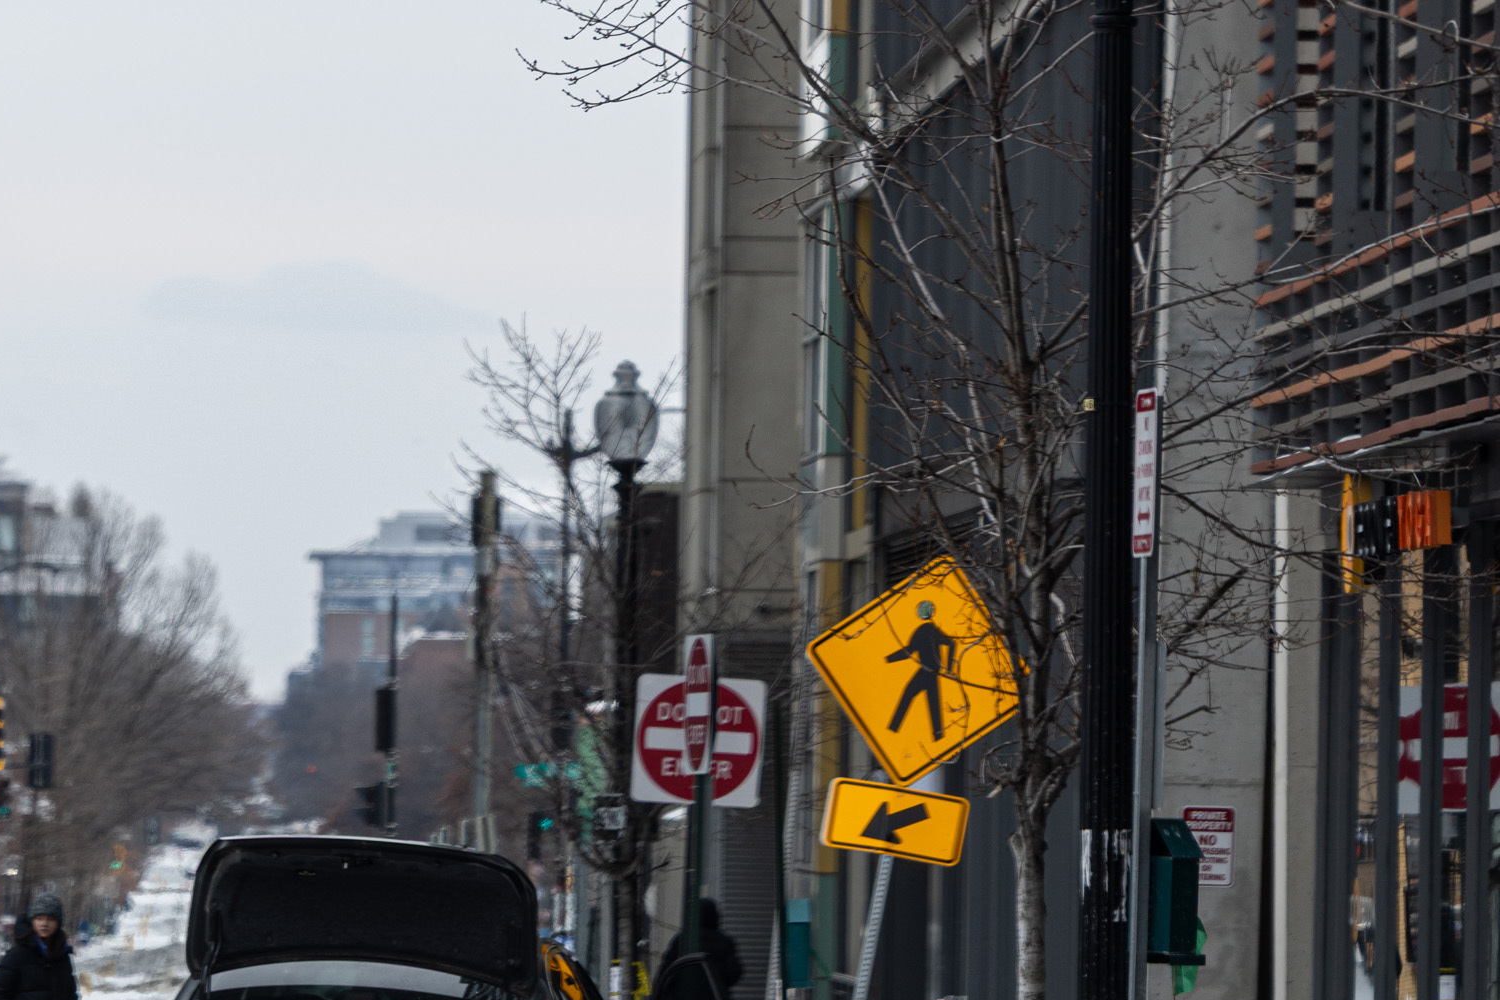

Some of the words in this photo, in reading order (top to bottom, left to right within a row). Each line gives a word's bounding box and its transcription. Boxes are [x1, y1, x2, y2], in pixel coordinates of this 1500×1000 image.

[656, 702, 687, 722] DO
[715, 706, 746, 726] OT
[1190, 811, 1228, 820] PRIVATE
[1186, 821, 1233, 831] PROPERTY
[1198, 834, 1217, 846] NO
